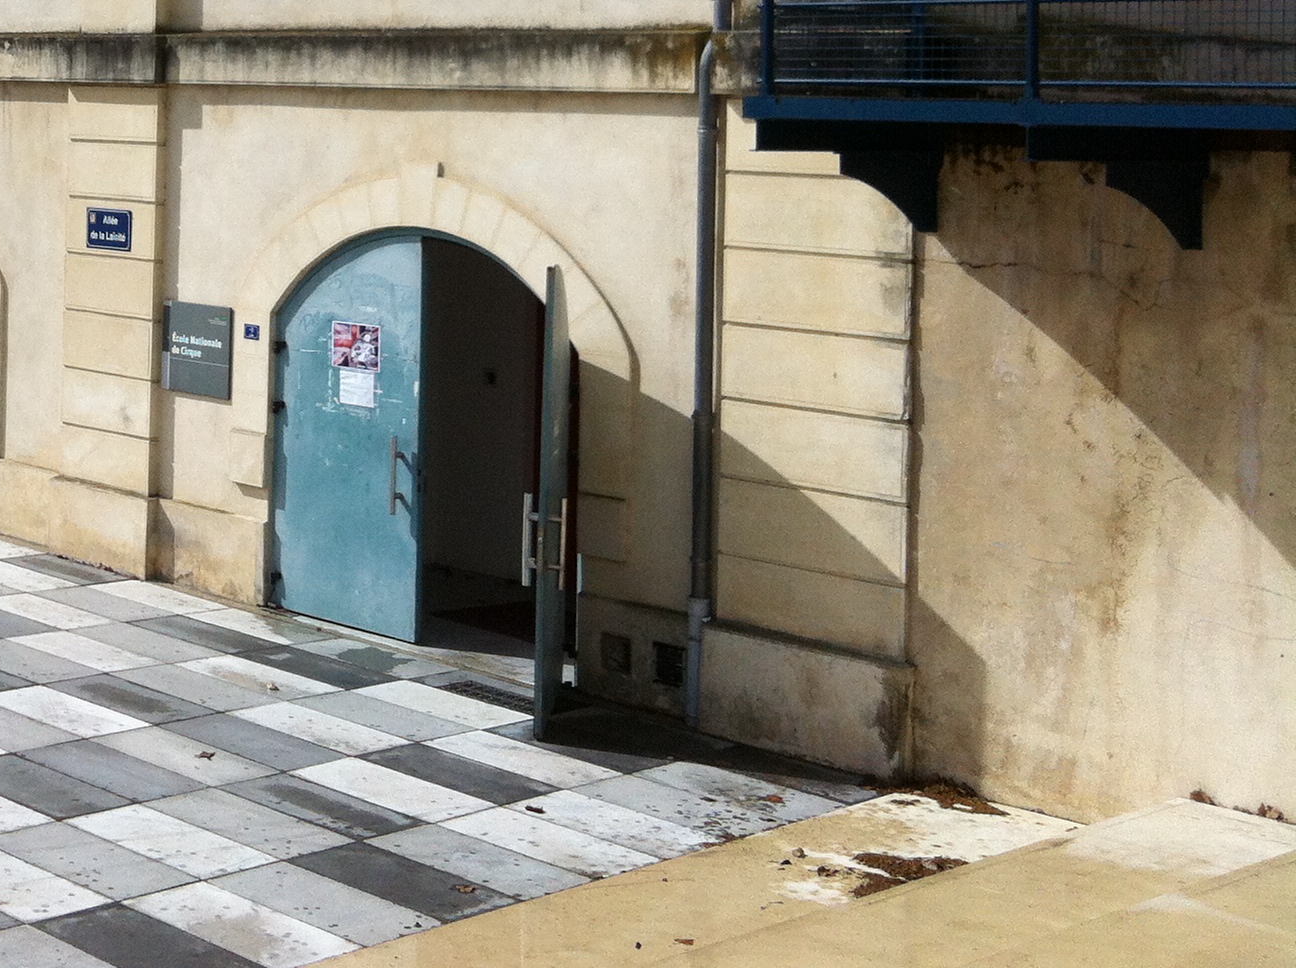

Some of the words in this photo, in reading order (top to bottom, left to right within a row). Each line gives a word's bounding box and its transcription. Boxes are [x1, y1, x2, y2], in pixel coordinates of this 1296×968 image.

[102, 215, 119, 225] Allée
[90, 230, 98, 239] de
[99, 231, 105, 240] la
[172, 331, 189, 344] École
[190, 335, 222, 348] Nationale
[171, 345, 180, 354] de
[180, 346, 202, 358] Cirque
